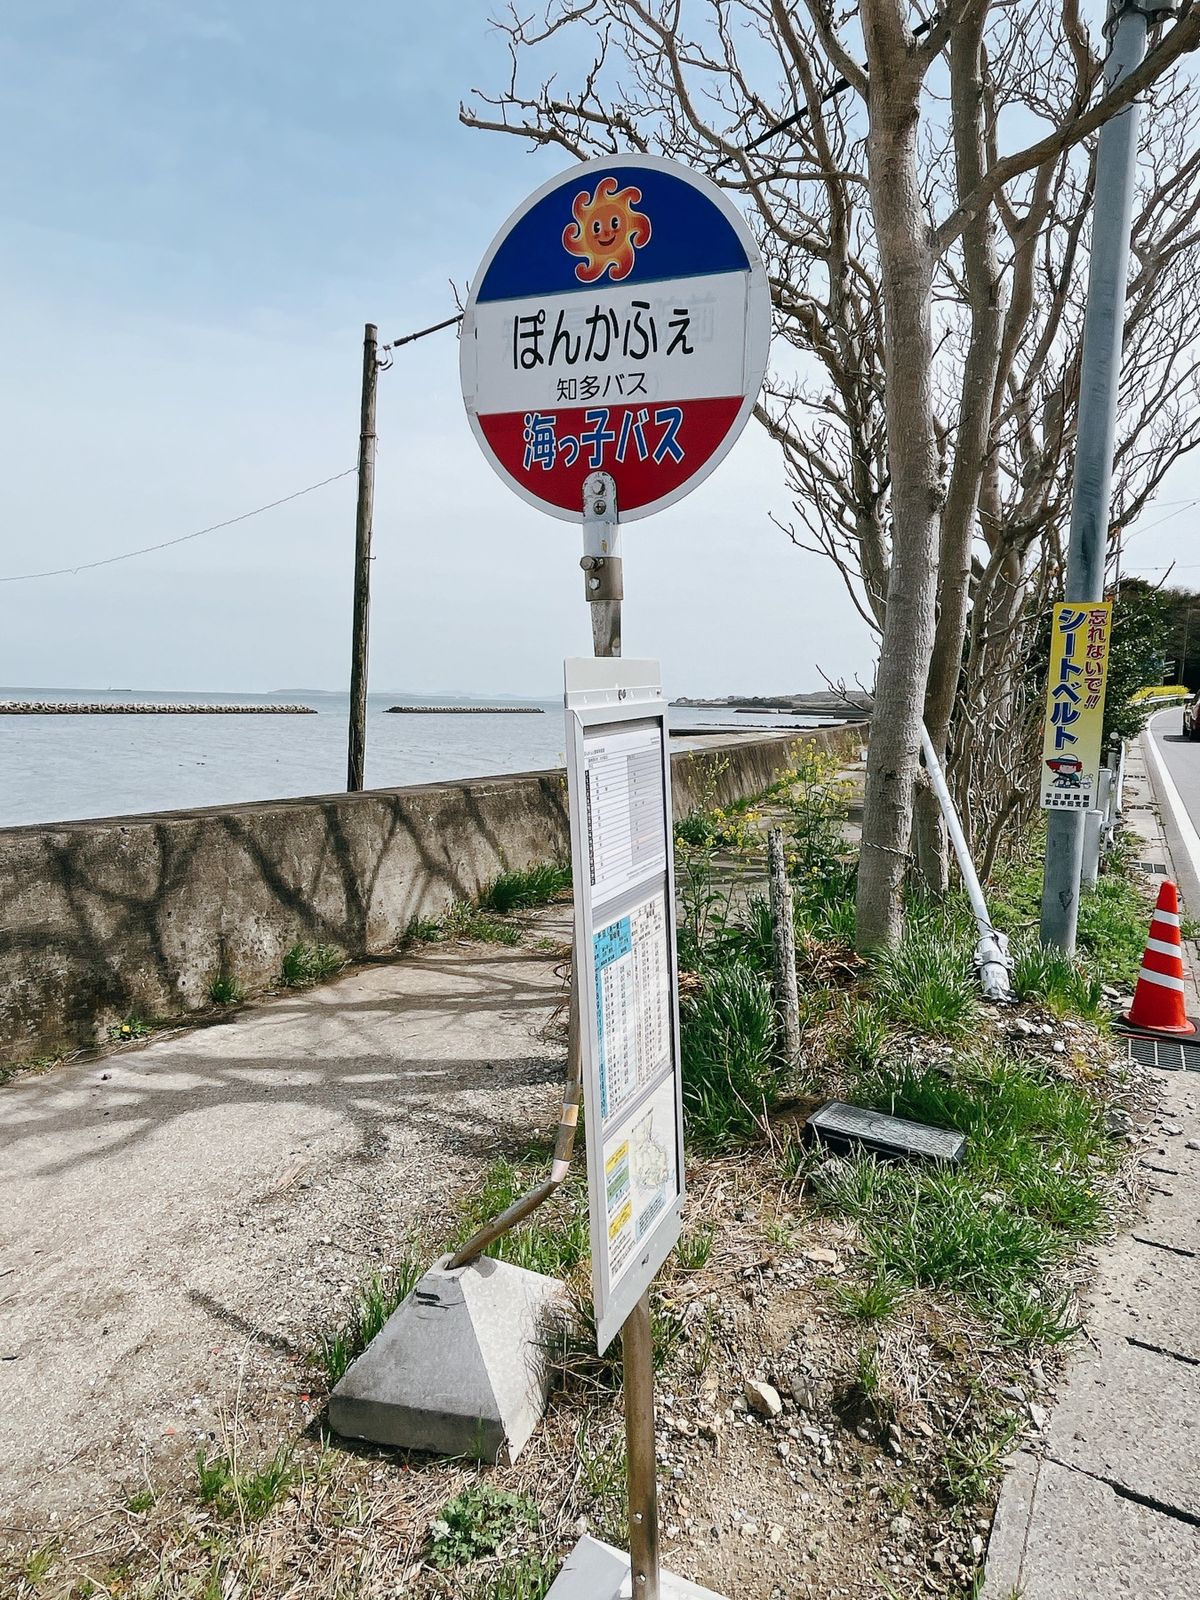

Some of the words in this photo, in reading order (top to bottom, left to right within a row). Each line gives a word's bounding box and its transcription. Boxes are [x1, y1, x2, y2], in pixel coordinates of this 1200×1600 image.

[513, 301, 694, 370] ぽんかふぇ
[557, 372, 648, 401] 知多バス
[522, 406, 685, 470] 海っ子バス
[1050, 608, 1087, 750] シートベルト
